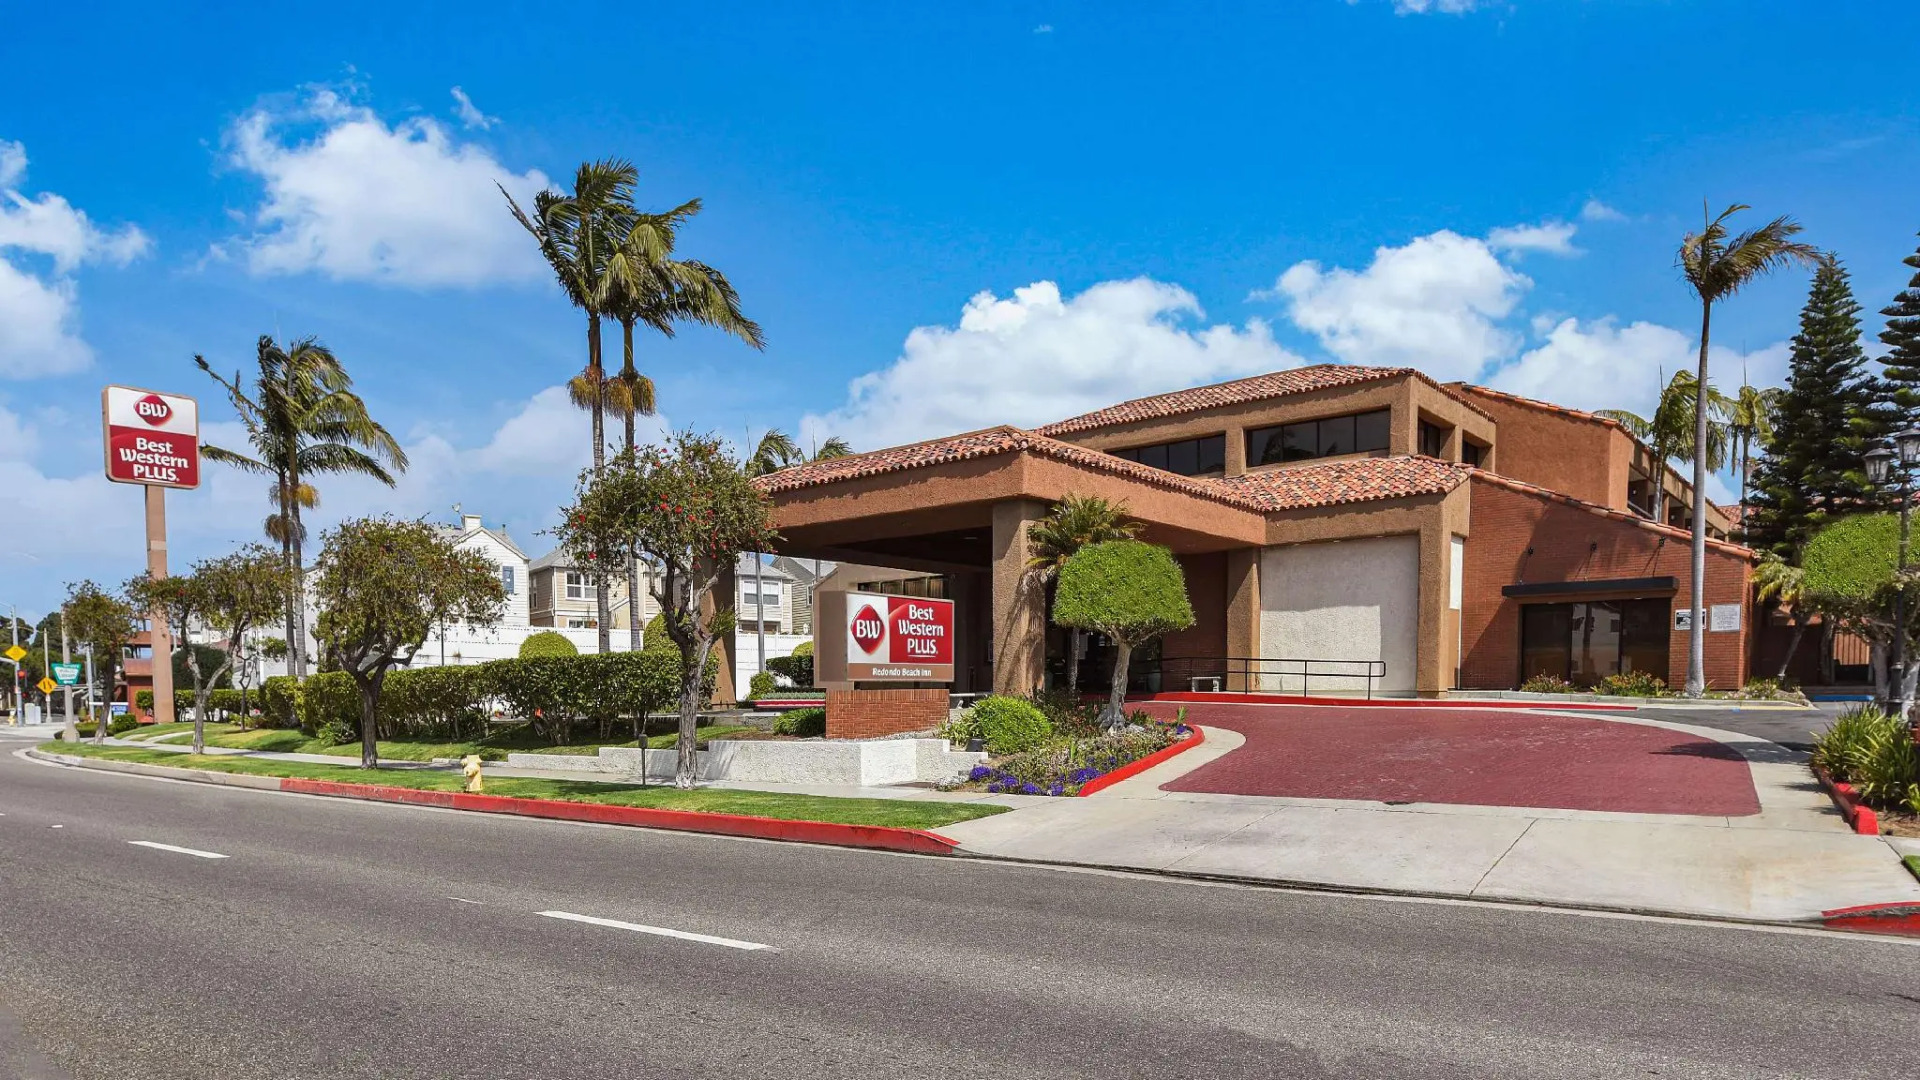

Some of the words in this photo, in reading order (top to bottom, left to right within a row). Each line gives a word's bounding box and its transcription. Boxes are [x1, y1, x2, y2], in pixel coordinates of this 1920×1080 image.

[139, 402, 168, 418] BW
[136, 437, 173, 454] Best
[119, 447, 189, 468] Western
[908, 604, 934, 621] Best
[856, 619, 881, 639] BW
[898, 619, 944, 637] Western
[872, 667, 900, 676] Redondo
[902, 667, 920, 677] Beach
[921, 668, 932, 677] Inn
